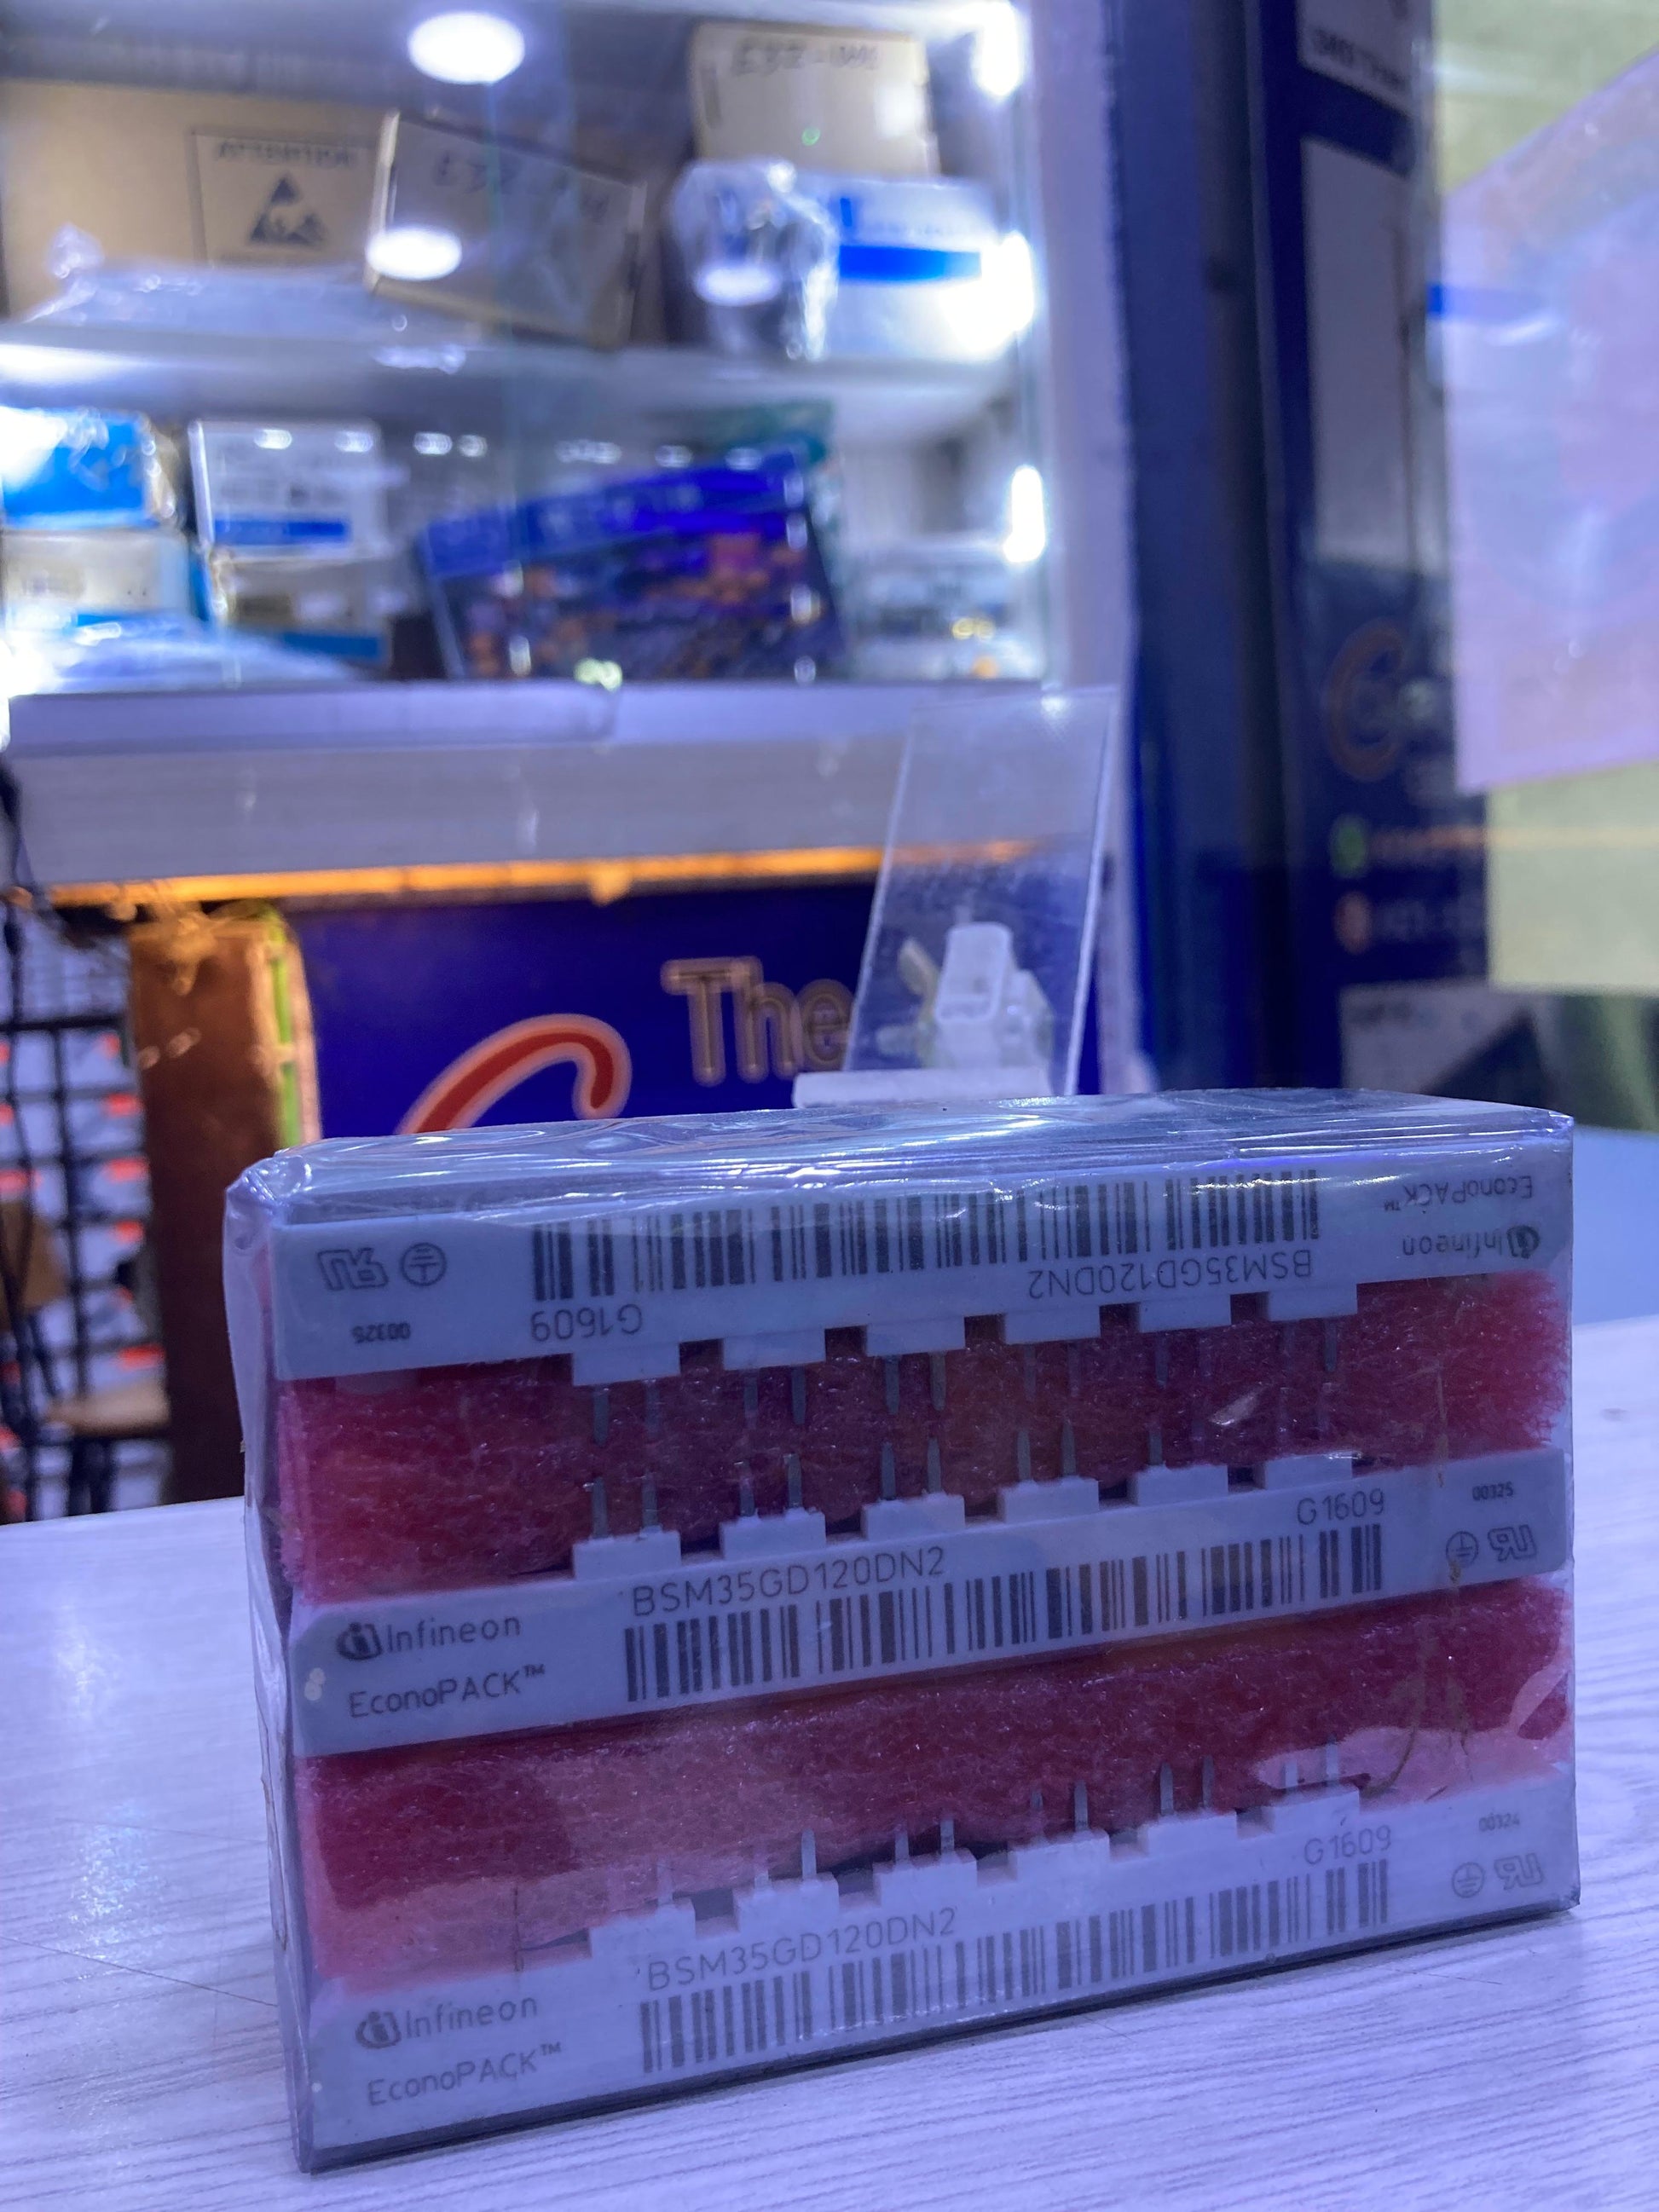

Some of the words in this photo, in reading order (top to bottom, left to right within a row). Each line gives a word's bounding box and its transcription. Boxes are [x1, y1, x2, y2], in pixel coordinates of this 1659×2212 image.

[661, 956, 853, 1086] The
[1402, 1228, 1502, 1258] Infineon
[1028, 1249, 1312, 1299] BSM35GD120DN2
[532, 1303, 643, 1343] G1609
[1297, 1487, 1384, 1525] G1609
[633, 1546, 945, 1617] BSM35GD120DN2
[387, 1616, 522, 1653] Infineon
[1304, 1824, 1391, 1865] G1609
[647, 1907, 957, 1991] BSM35GD120DN2
[405, 1996, 538, 2039] Infineon
